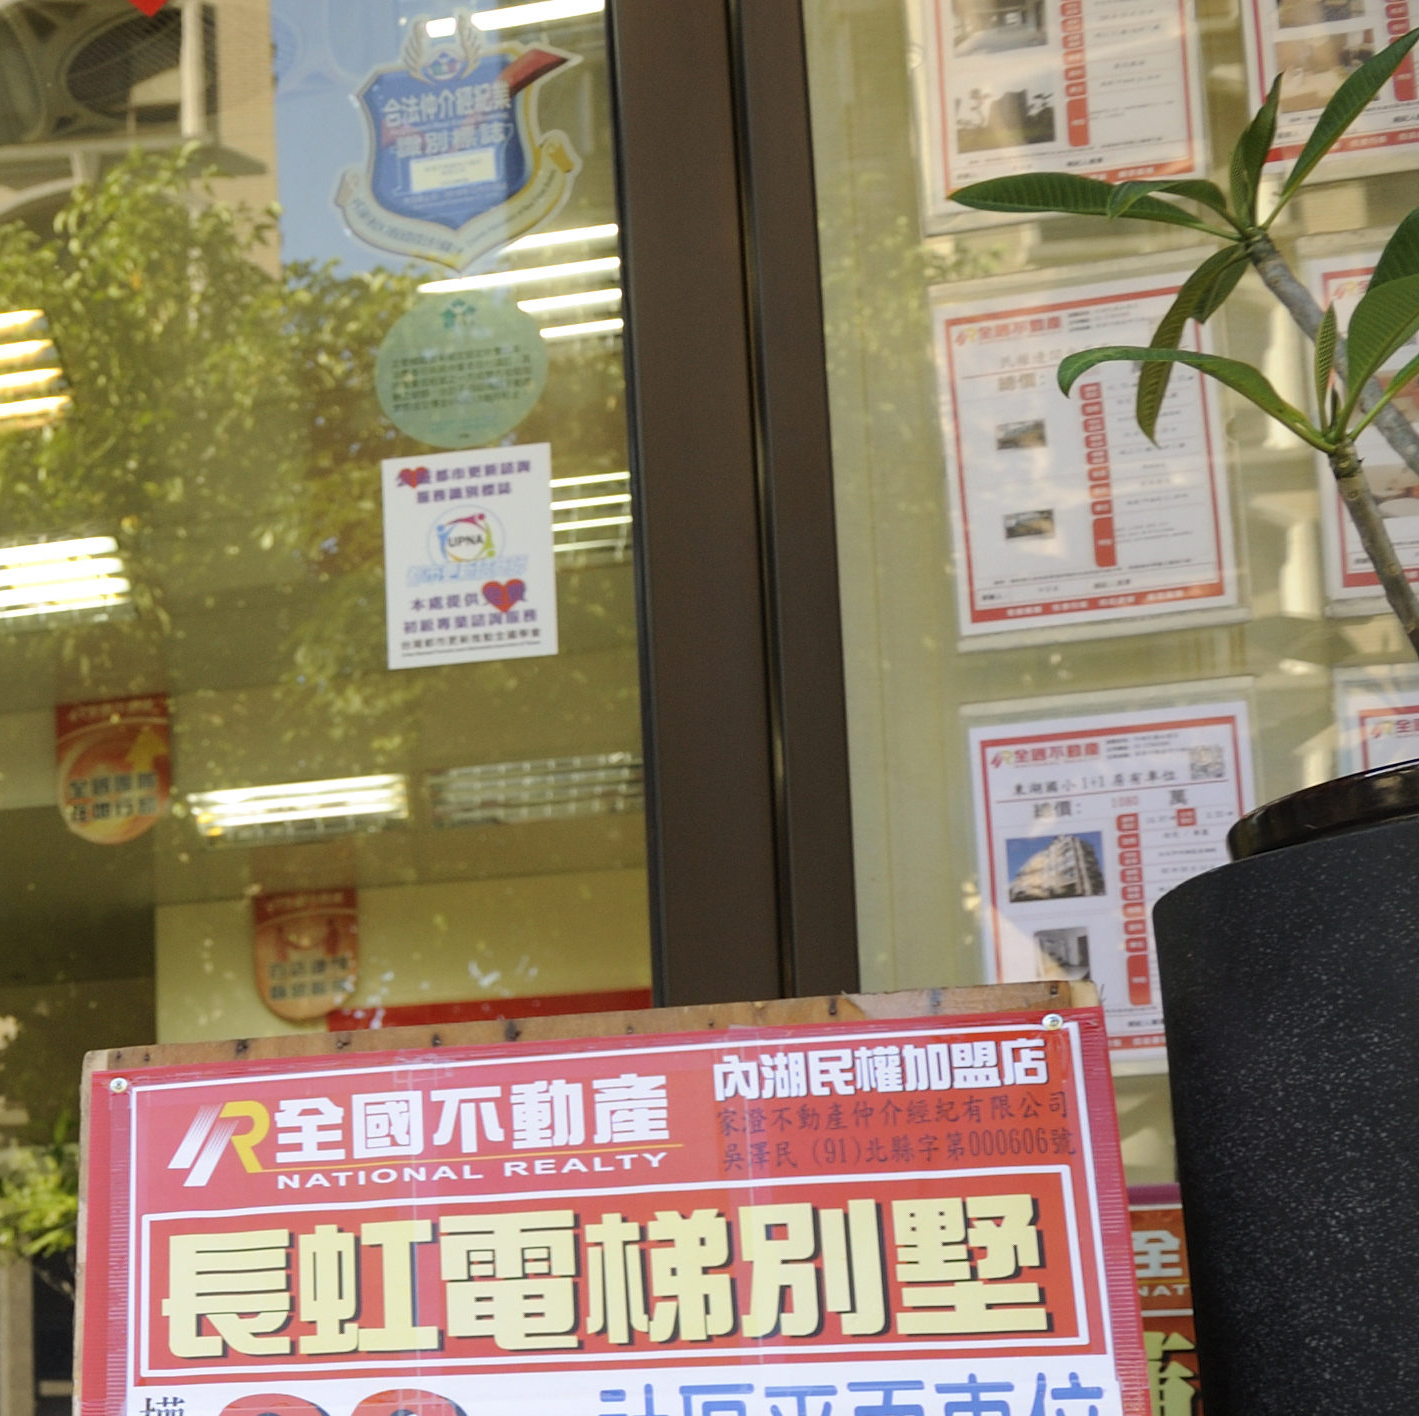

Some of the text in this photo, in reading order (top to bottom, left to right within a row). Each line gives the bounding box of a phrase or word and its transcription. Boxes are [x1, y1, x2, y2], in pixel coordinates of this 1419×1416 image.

[448, 534, 484, 548] UPNA
[712, 1037, 1049, 1102] 內湖民權加盟店
[273, 1073, 671, 1165] 全國不動產
[276, 1151, 669, 1191] NATIONAL REALTY
[163, 1194, 1053, 1361] 長虹電梯別墅
